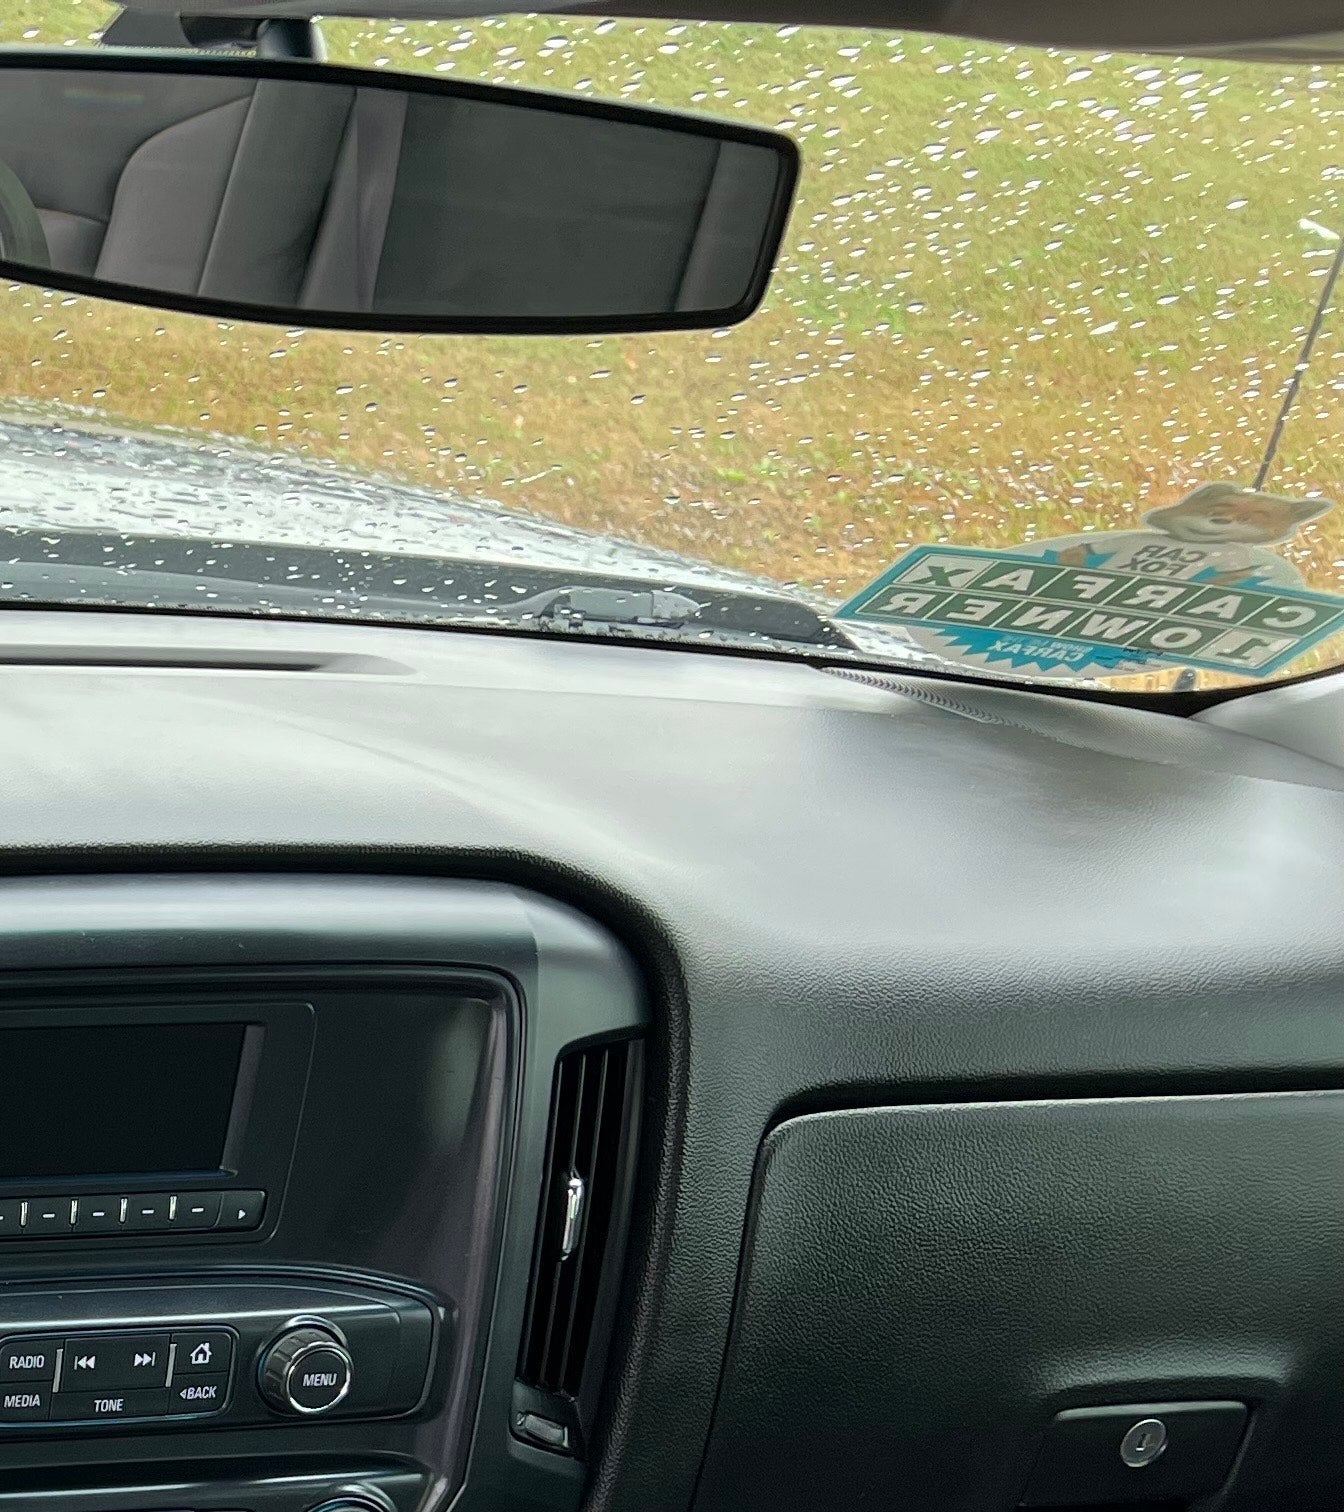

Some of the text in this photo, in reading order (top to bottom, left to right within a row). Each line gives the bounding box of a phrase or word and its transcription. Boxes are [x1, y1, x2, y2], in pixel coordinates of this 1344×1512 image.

[8, 1355, 45, 1370] RADIO
[302, 1372, 338, 1387] MENU
[186, 1385, 217, 1400] BACK
[3, 1394, 41, 1408] MEDIA
[93, 1398, 124, 1413] TONE
